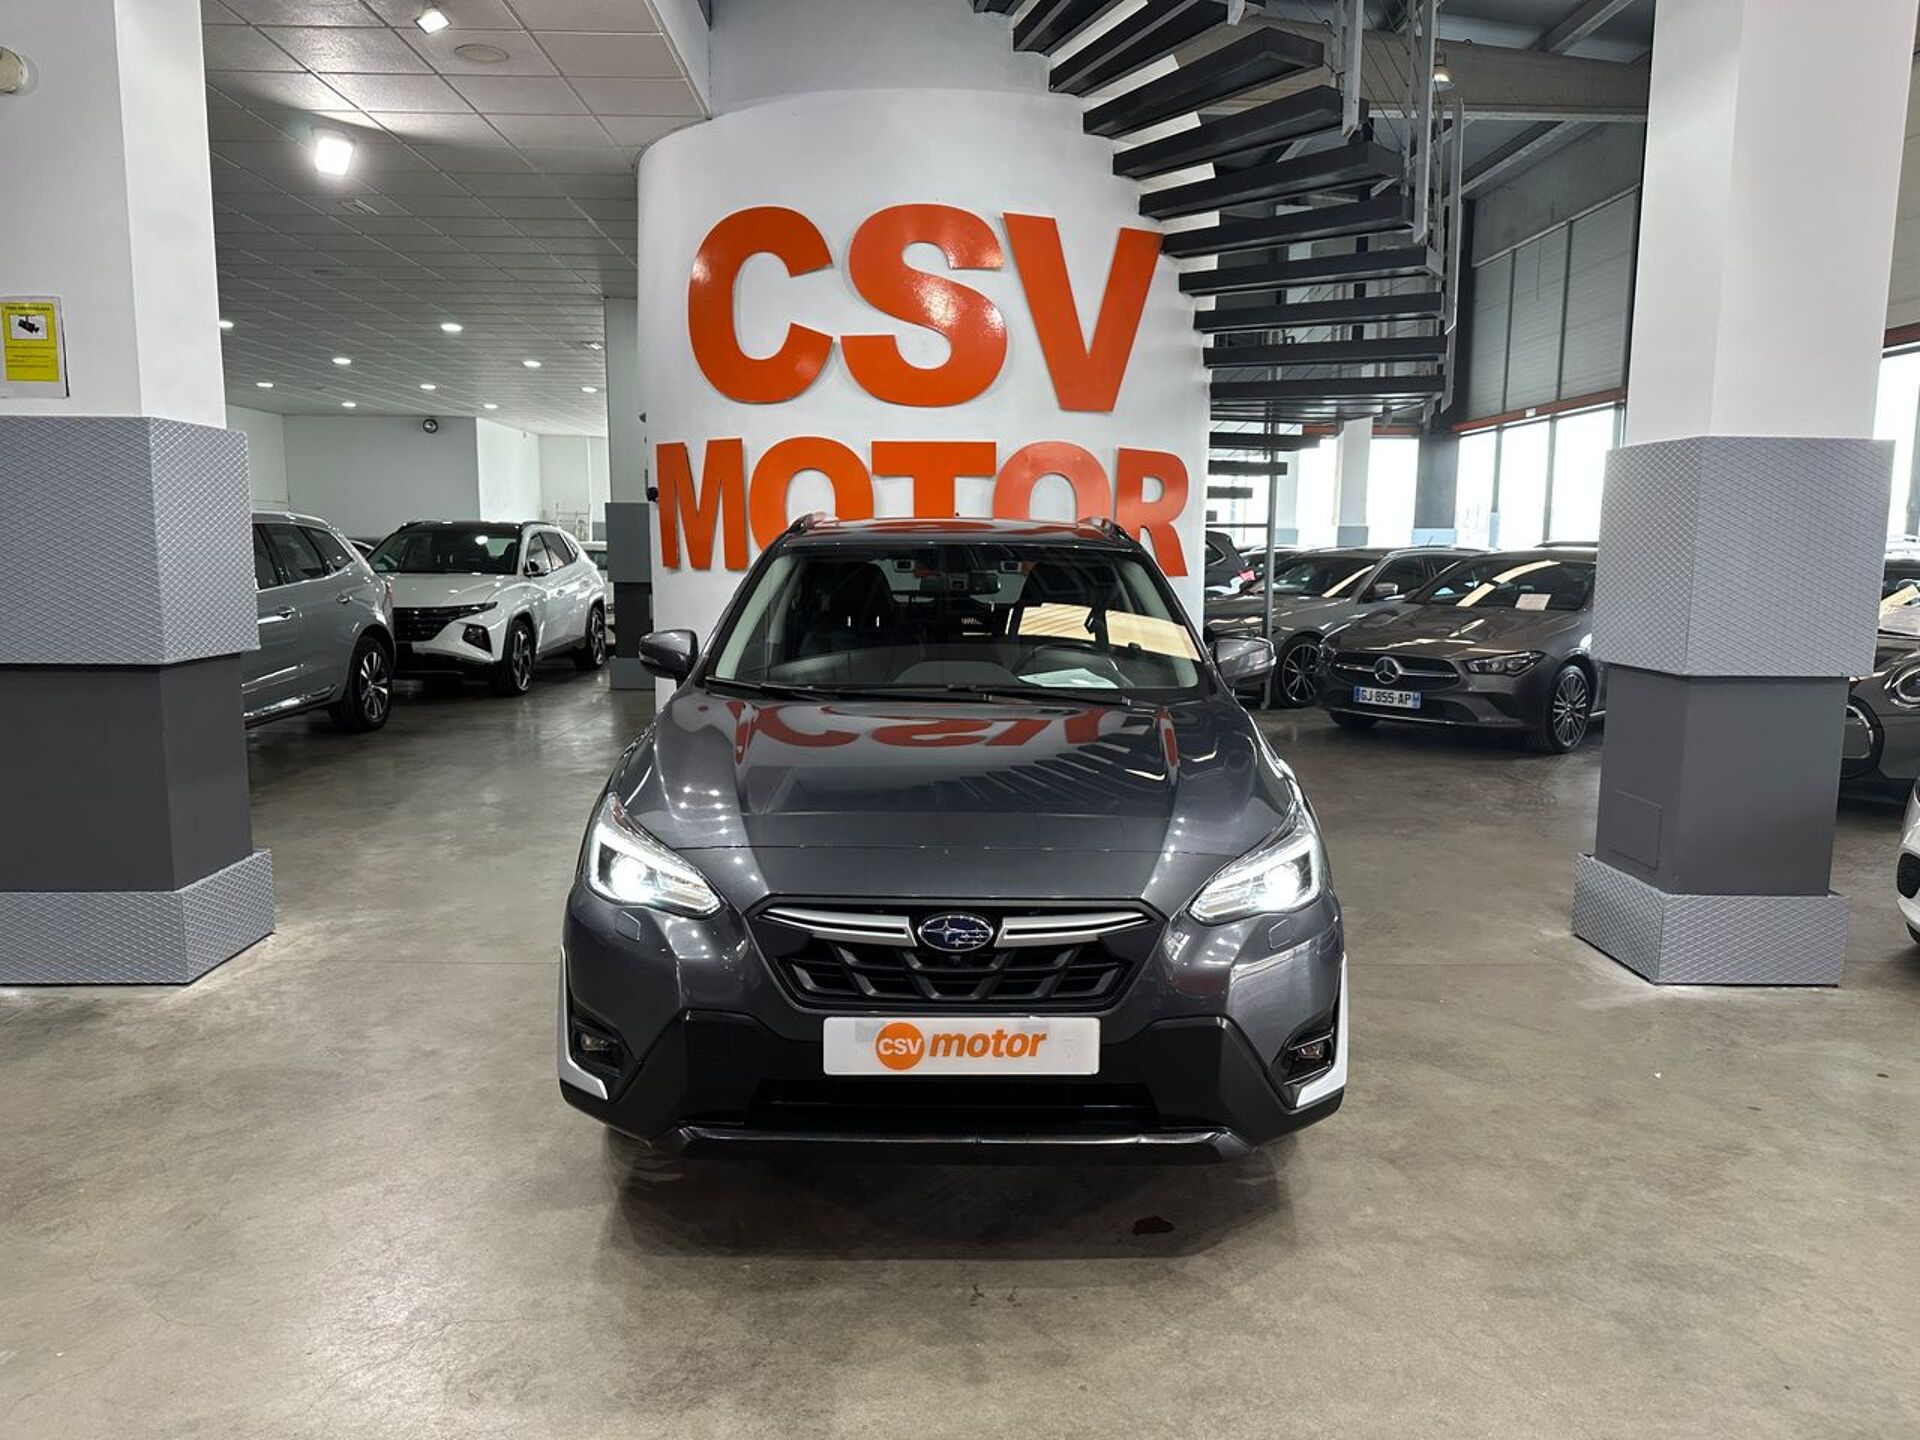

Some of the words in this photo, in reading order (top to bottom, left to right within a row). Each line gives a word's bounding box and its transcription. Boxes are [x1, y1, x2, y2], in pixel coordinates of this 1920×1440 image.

[688, 203, 1164, 412] CSV
[656, 437, 1190, 577] MOTOR
[878, 1036, 922, 1055] CSV
[929, 1028, 1048, 1058] motor
